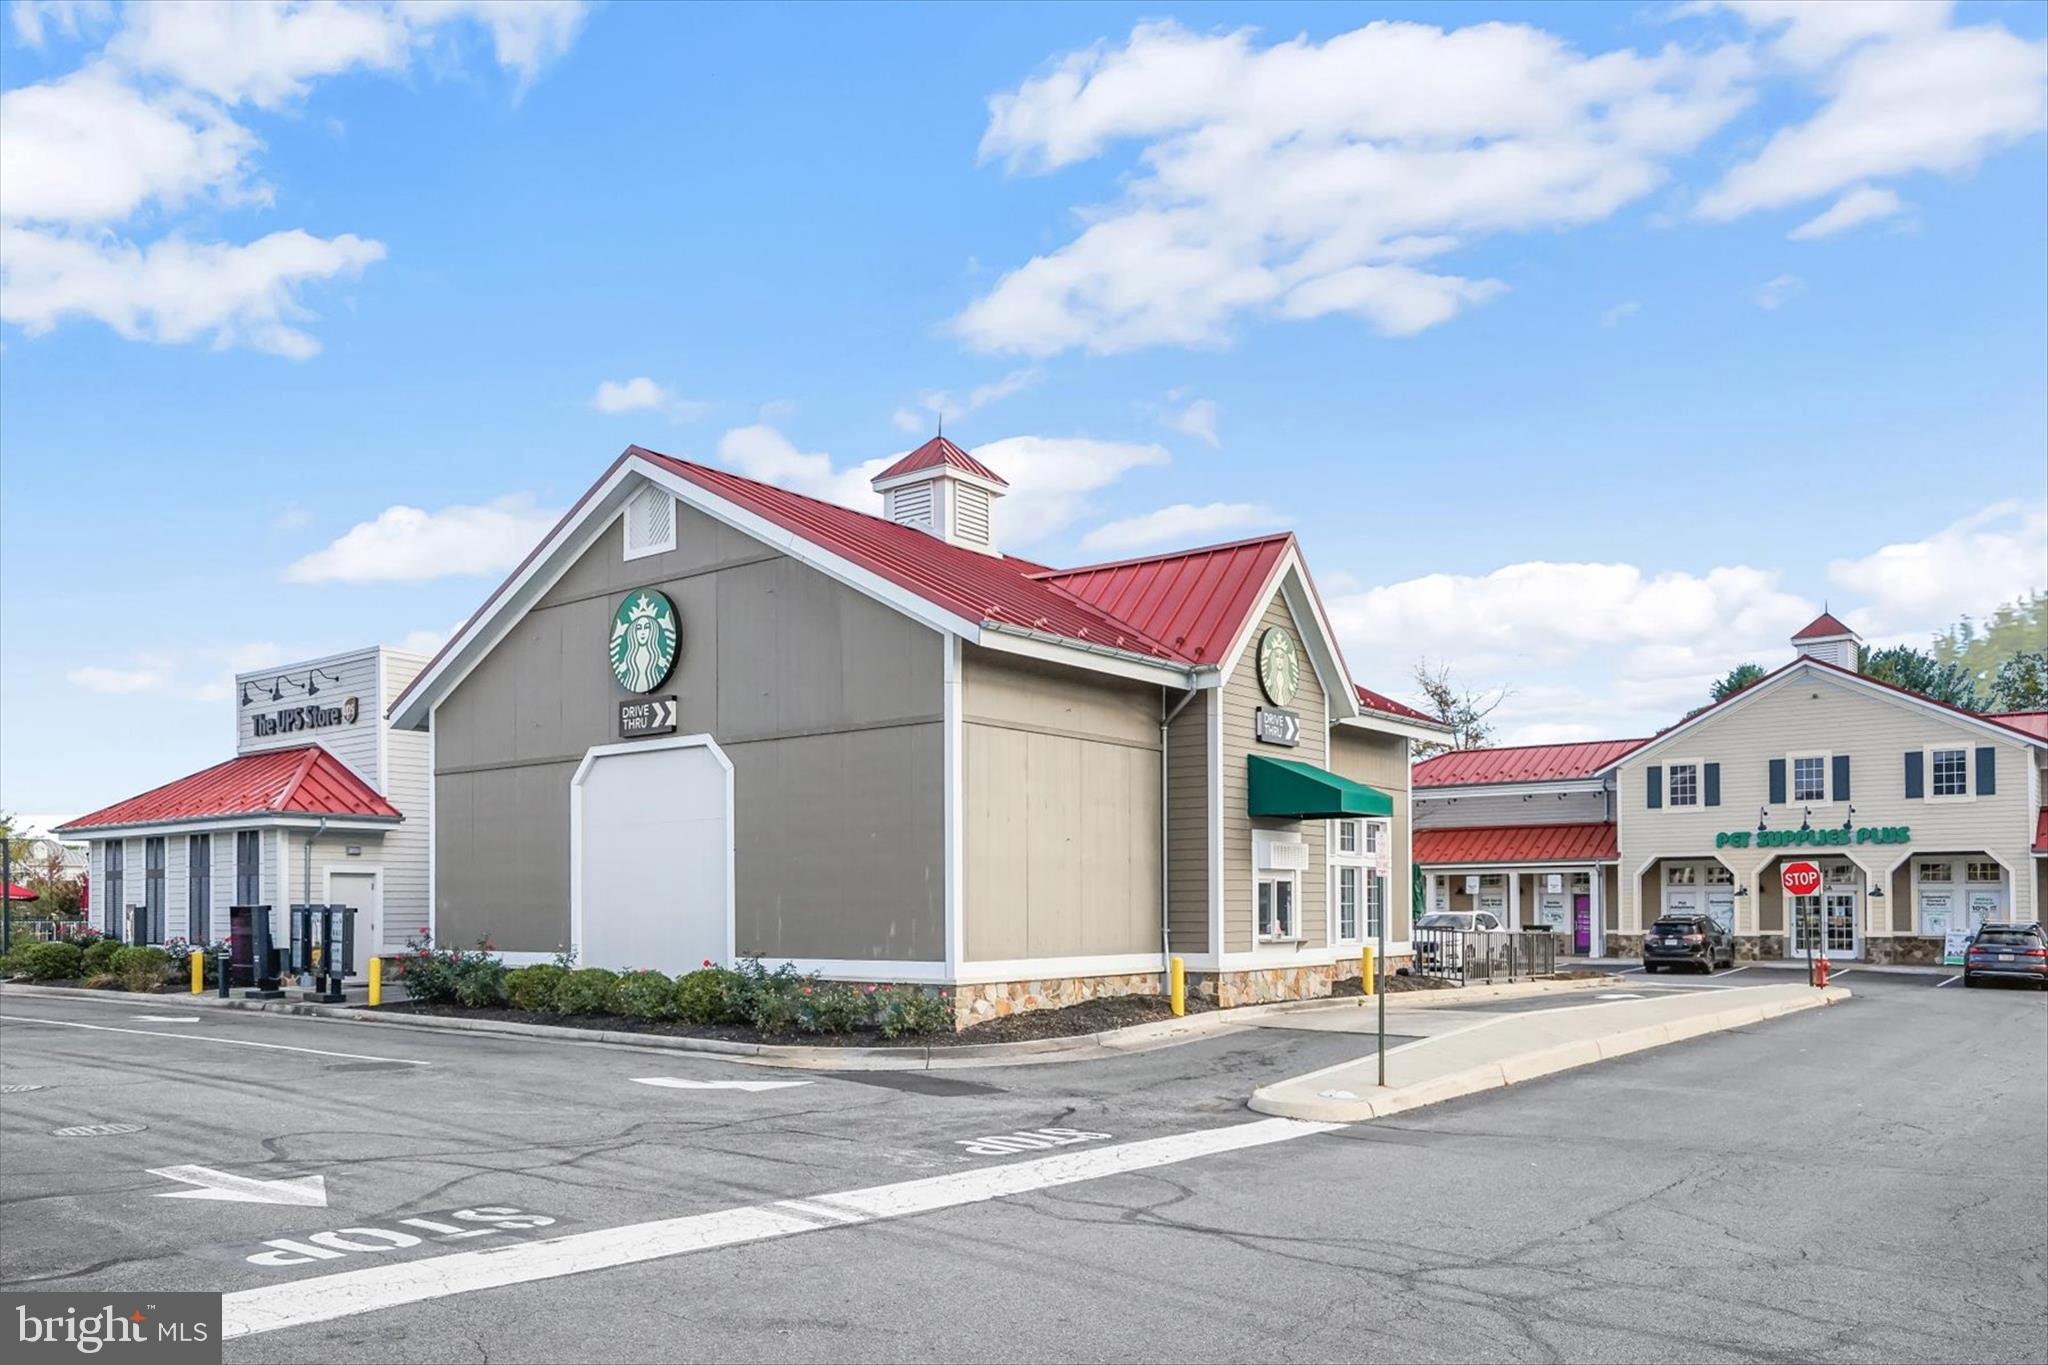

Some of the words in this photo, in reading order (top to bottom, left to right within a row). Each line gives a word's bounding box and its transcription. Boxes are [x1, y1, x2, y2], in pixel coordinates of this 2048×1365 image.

[622, 704, 650, 719] DRIVE
[1263, 712, 1284, 727] DRIVE
[252, 713, 277, 737] The
[277, 707, 305, 733] UPS
[305, 705, 342, 729] Store
[622, 716, 648, 730] THRU
[1264, 724, 1283, 738] THRU
[1716, 831, 1751, 849] PET
[1756, 828, 1851, 848] SUPPLIES
[1855, 826, 1911, 845] PLUS
[1785, 871, 1818, 887] STOP
[954, 1127, 1113, 1155] STOP
[246, 1206, 556, 1266] STOP
